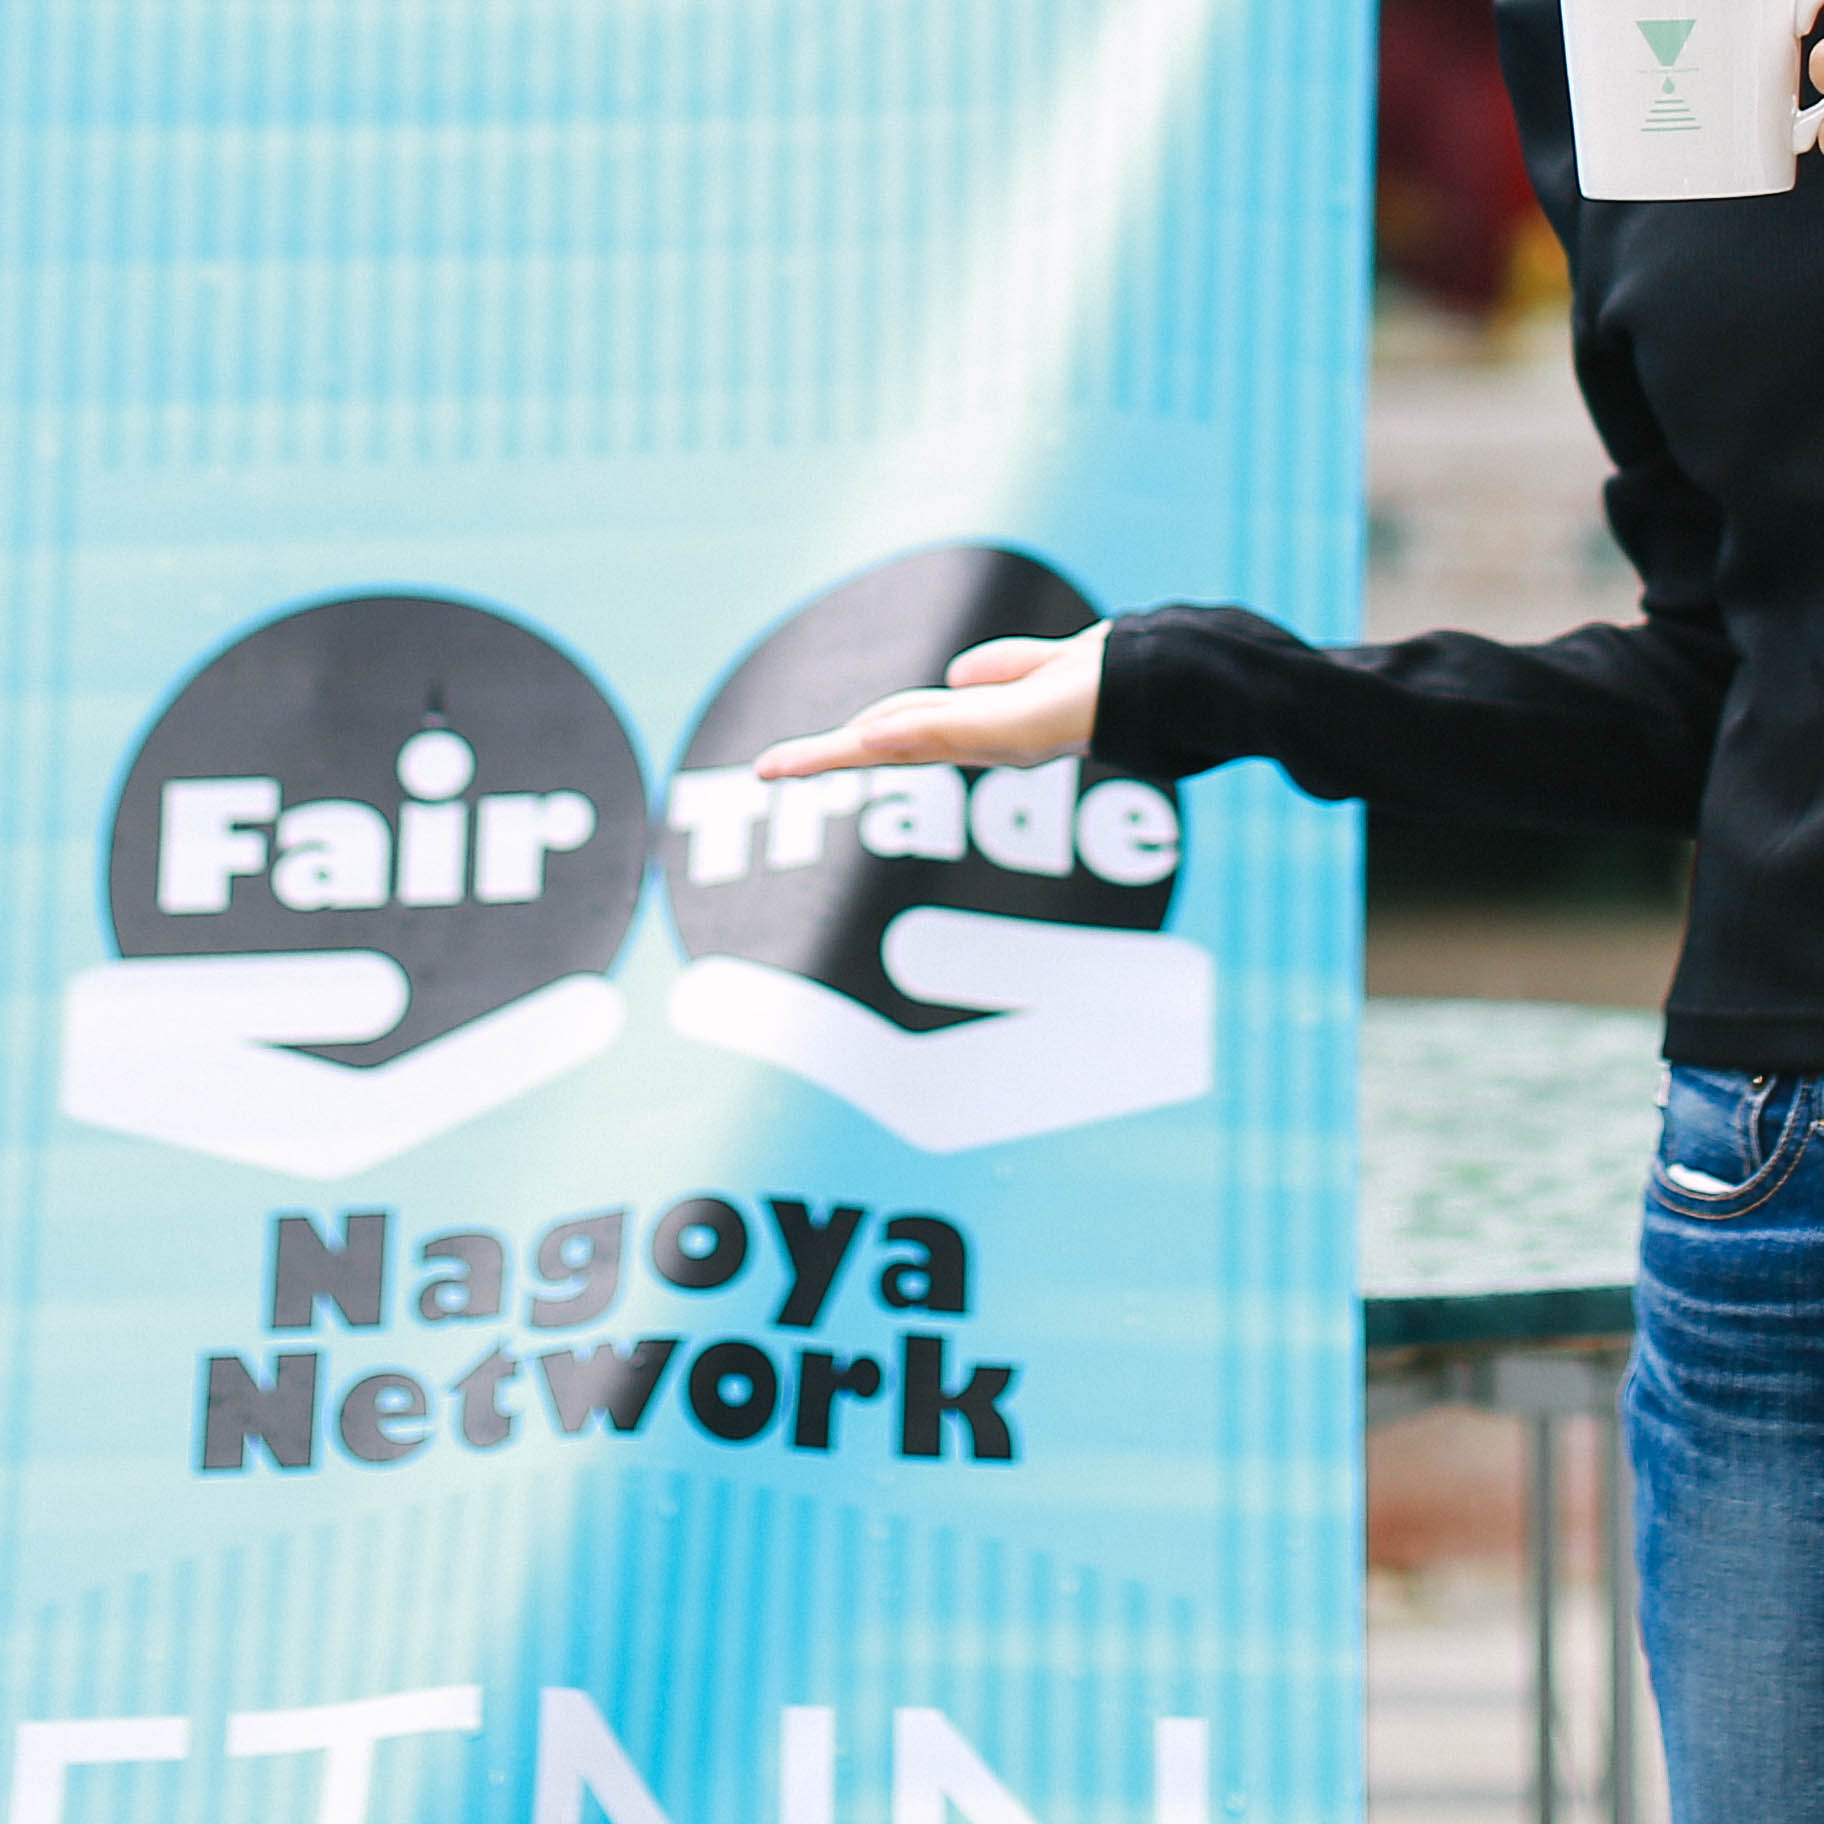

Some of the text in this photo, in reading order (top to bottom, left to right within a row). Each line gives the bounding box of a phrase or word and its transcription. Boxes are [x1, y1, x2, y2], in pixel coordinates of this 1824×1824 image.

[156, 728, 1180, 914] Fair Trade
[270, 1195, 968, 1329] Nagoya
[201, 1335, 1016, 1473] Network
